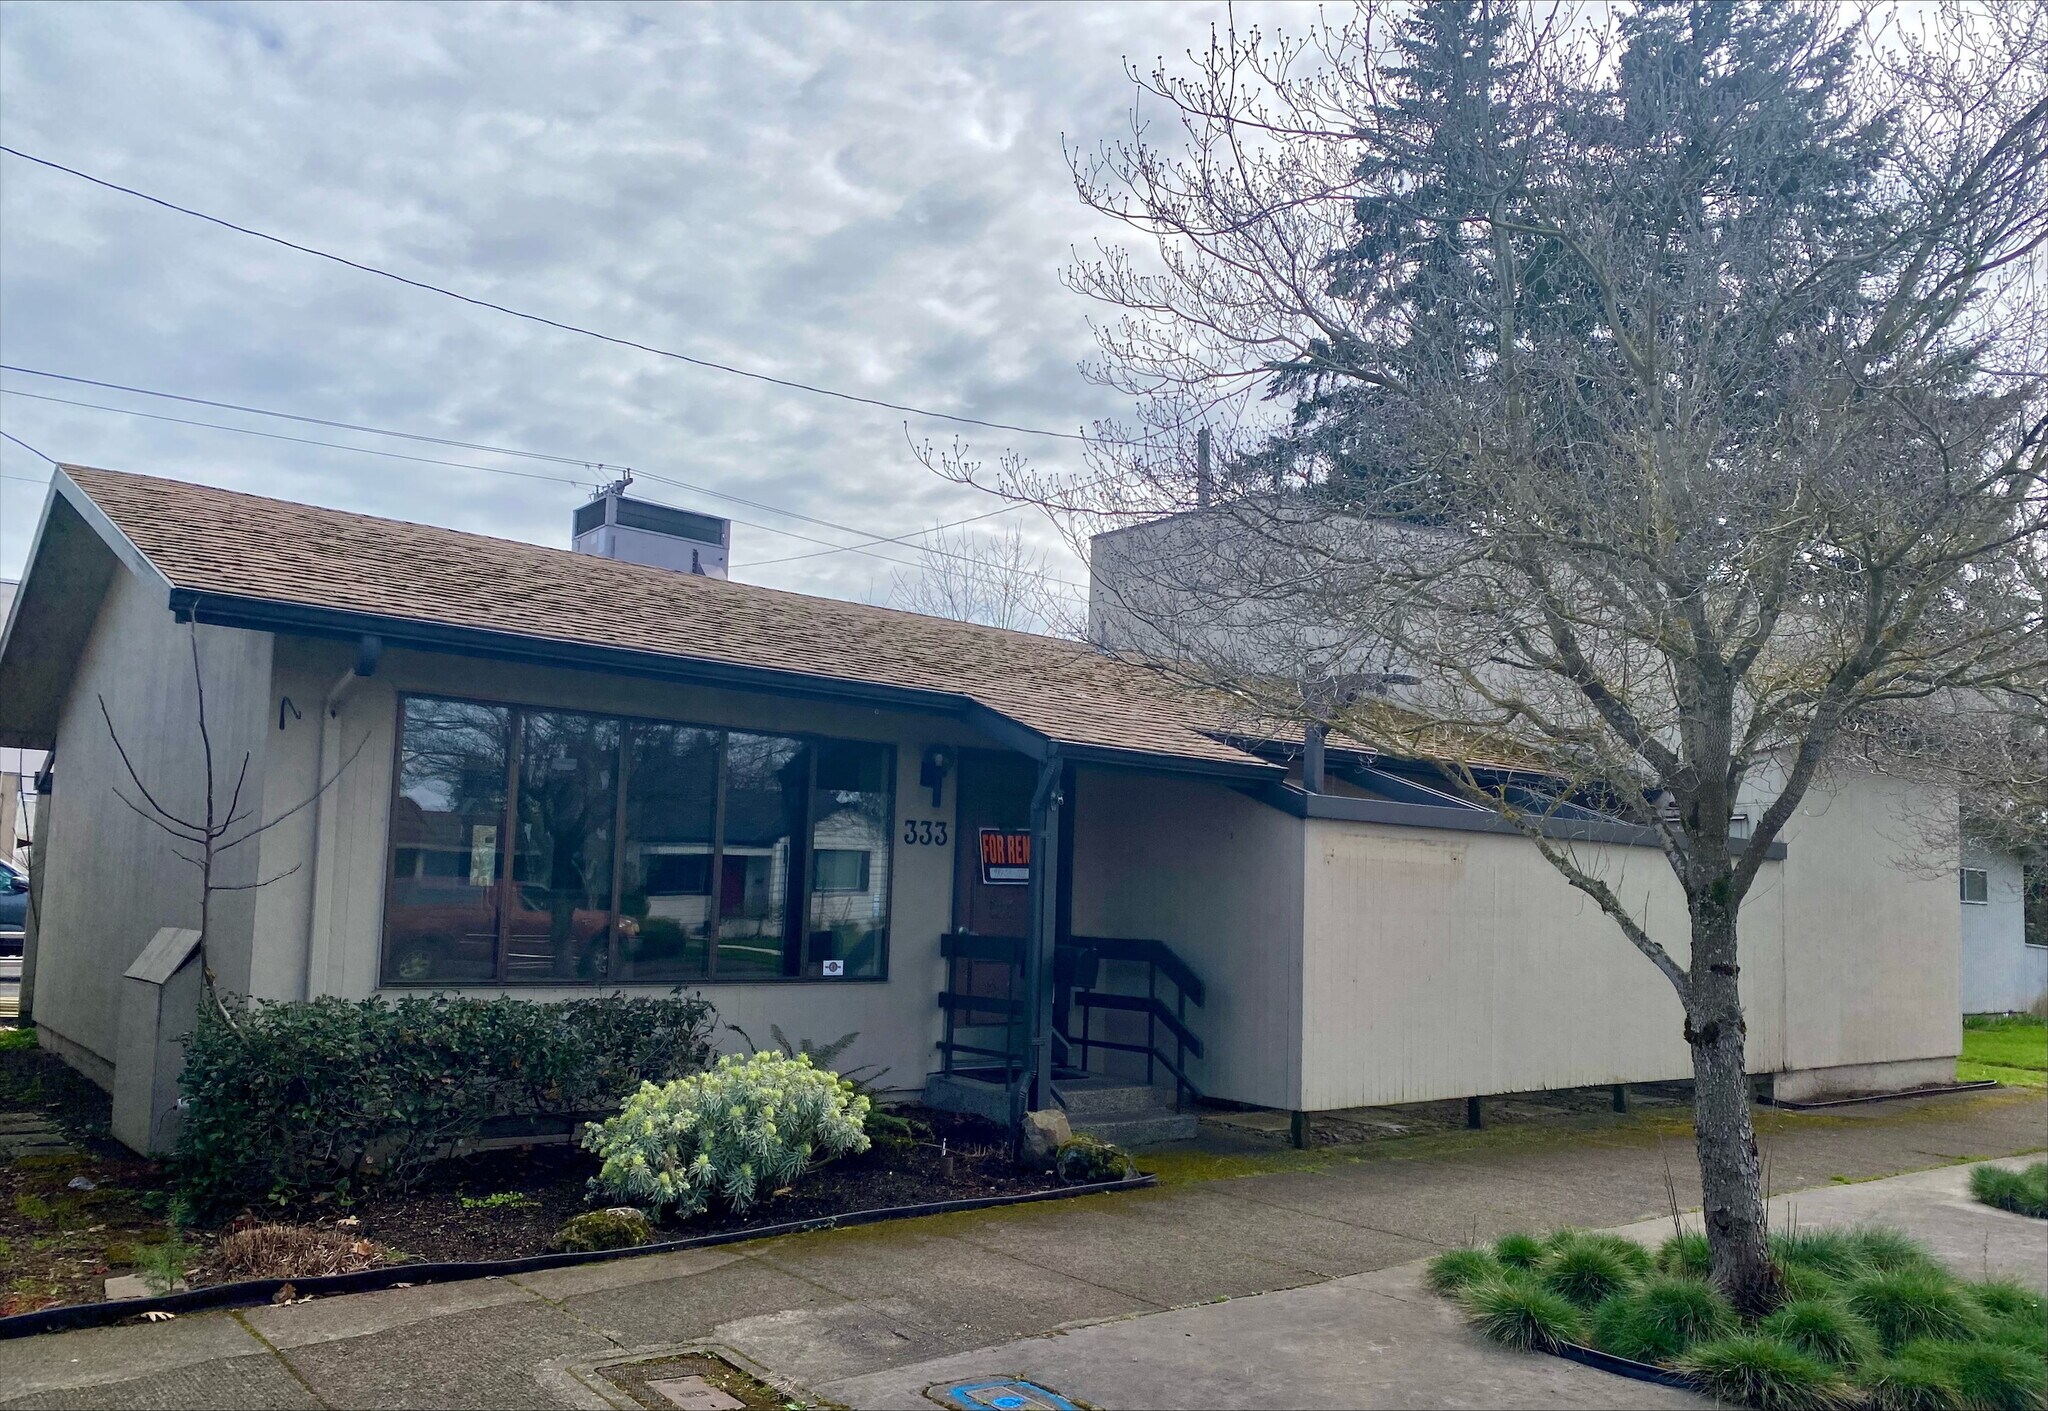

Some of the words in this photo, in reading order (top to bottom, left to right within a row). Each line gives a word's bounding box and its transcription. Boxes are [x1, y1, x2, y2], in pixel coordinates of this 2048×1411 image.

[904, 820, 948, 846] 333
[982, 834, 1004, 864] FOR
[1007, 835, 1030, 864] REN
